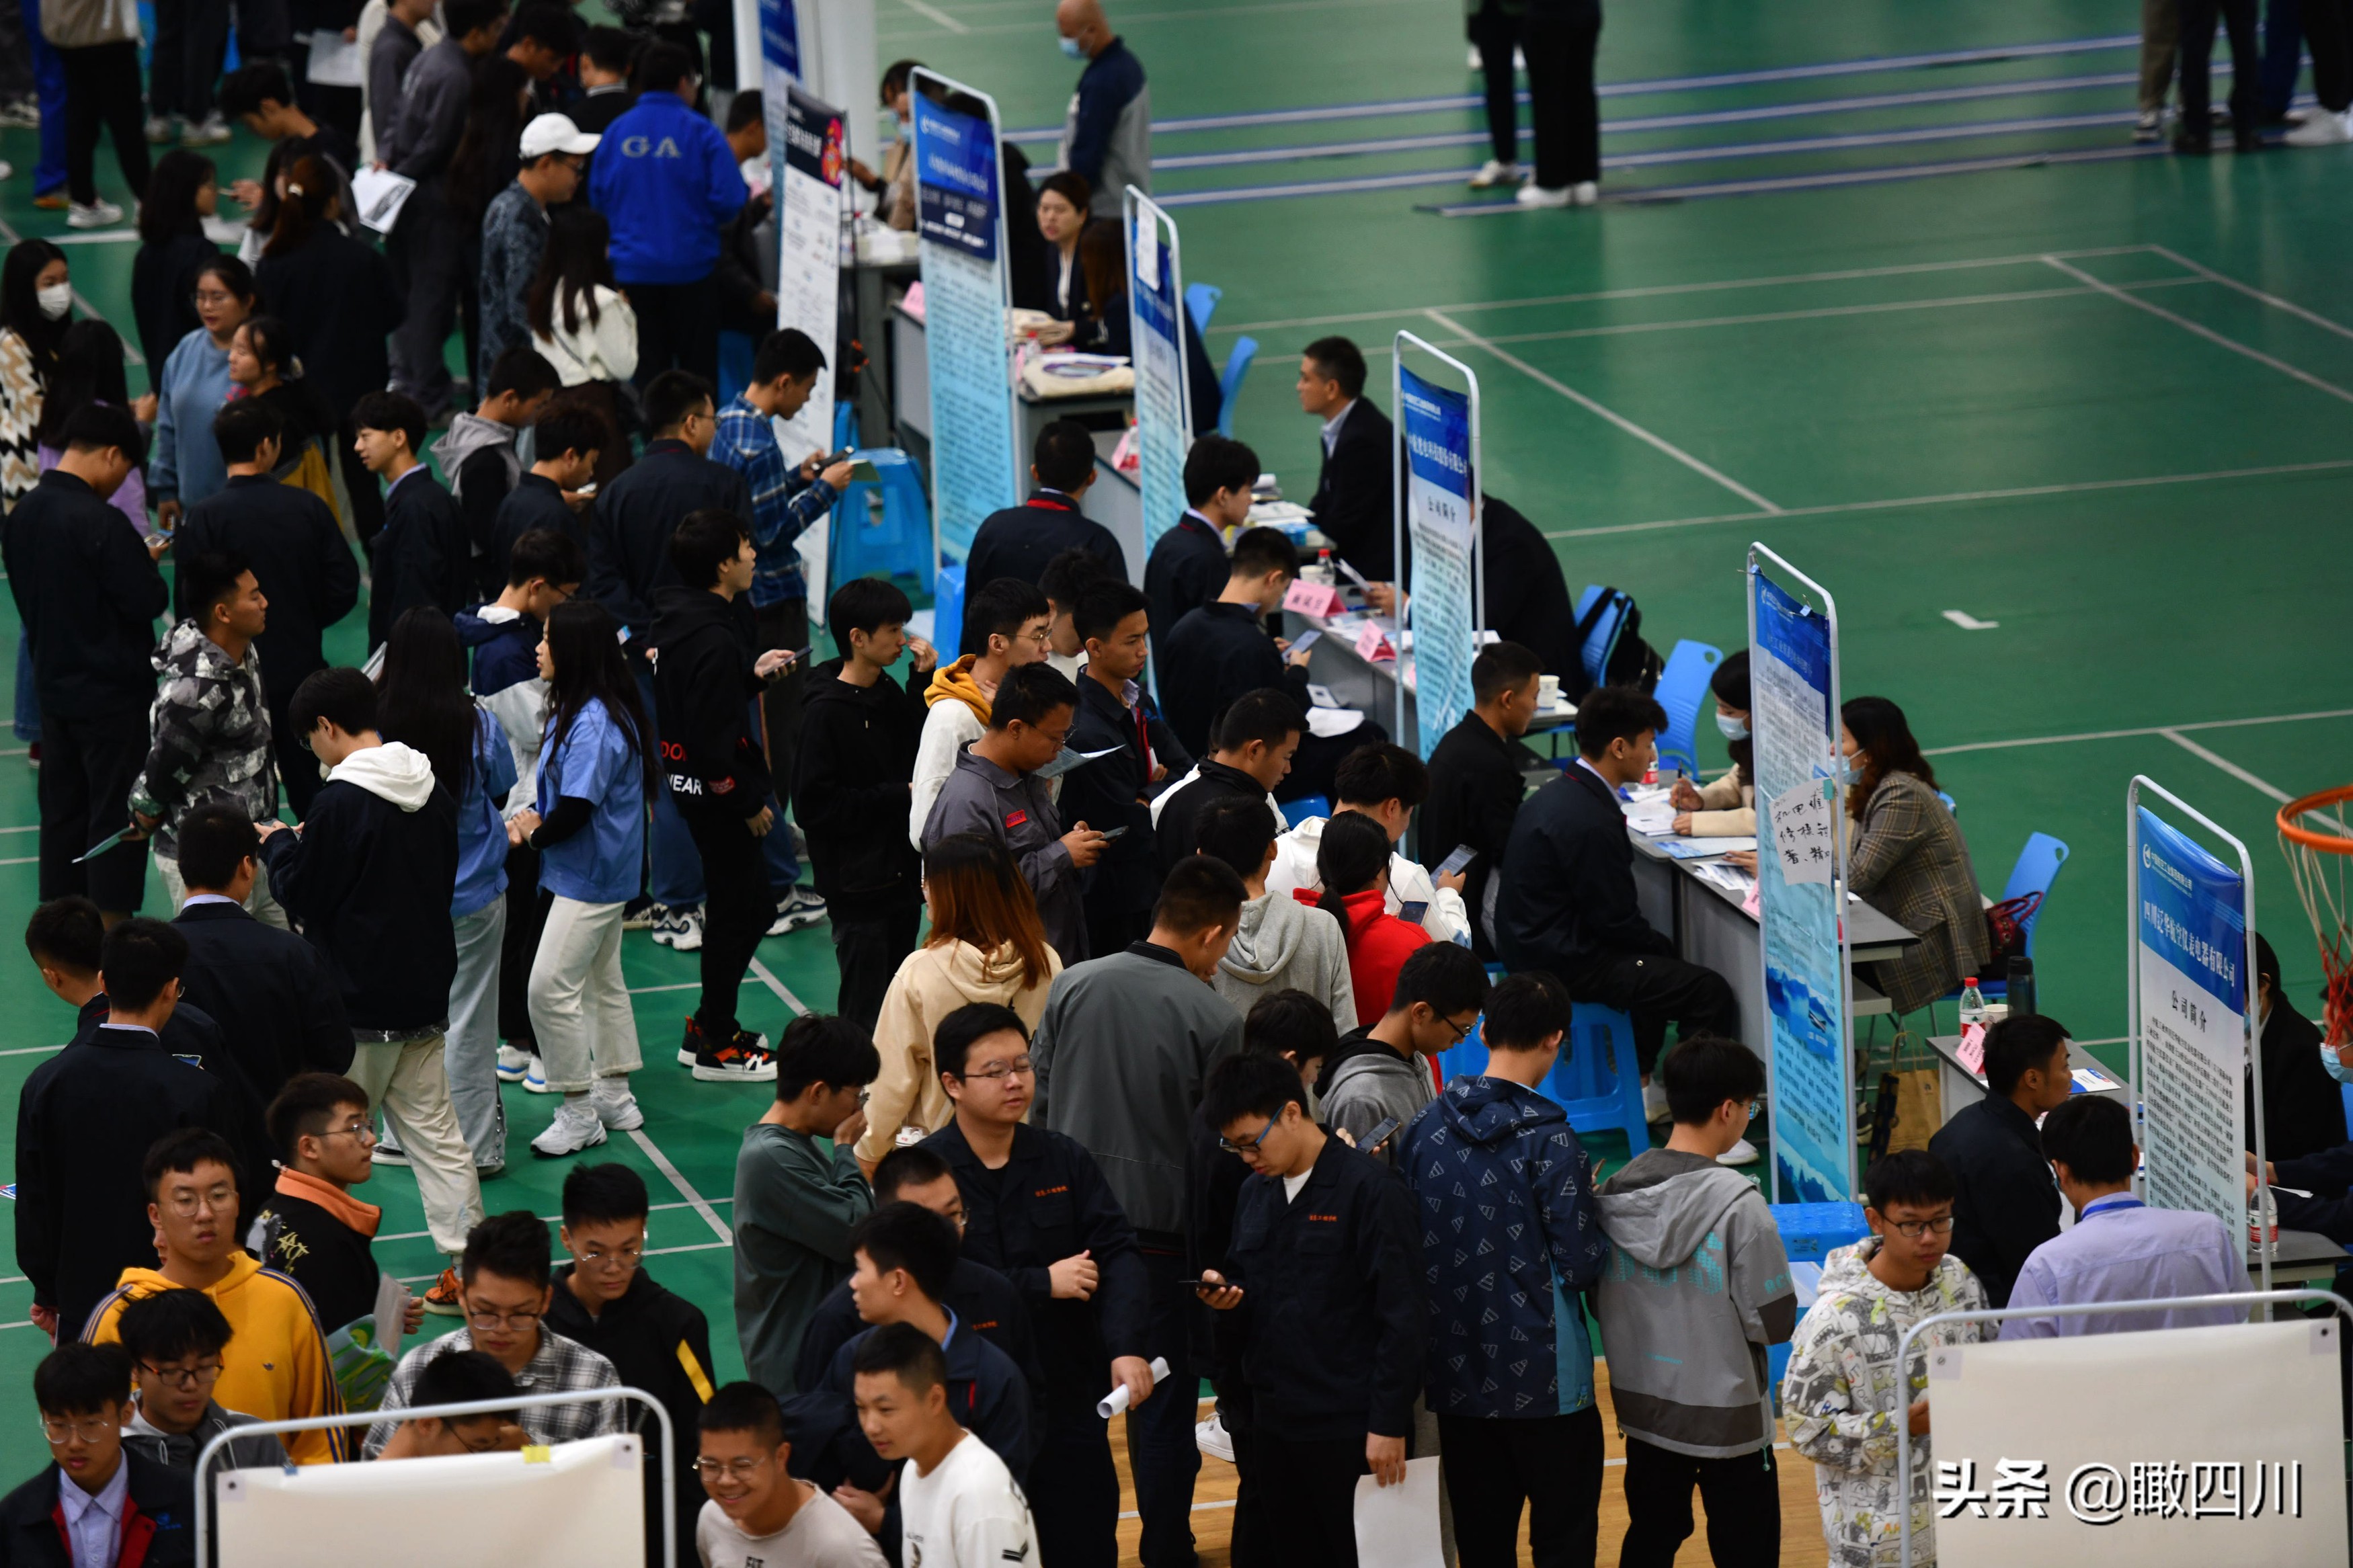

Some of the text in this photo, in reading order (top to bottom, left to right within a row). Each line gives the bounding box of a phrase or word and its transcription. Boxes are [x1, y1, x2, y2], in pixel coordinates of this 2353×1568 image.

[621, 135, 682, 159] GA
[2171, 989, 2207, 1033] 公司简介
